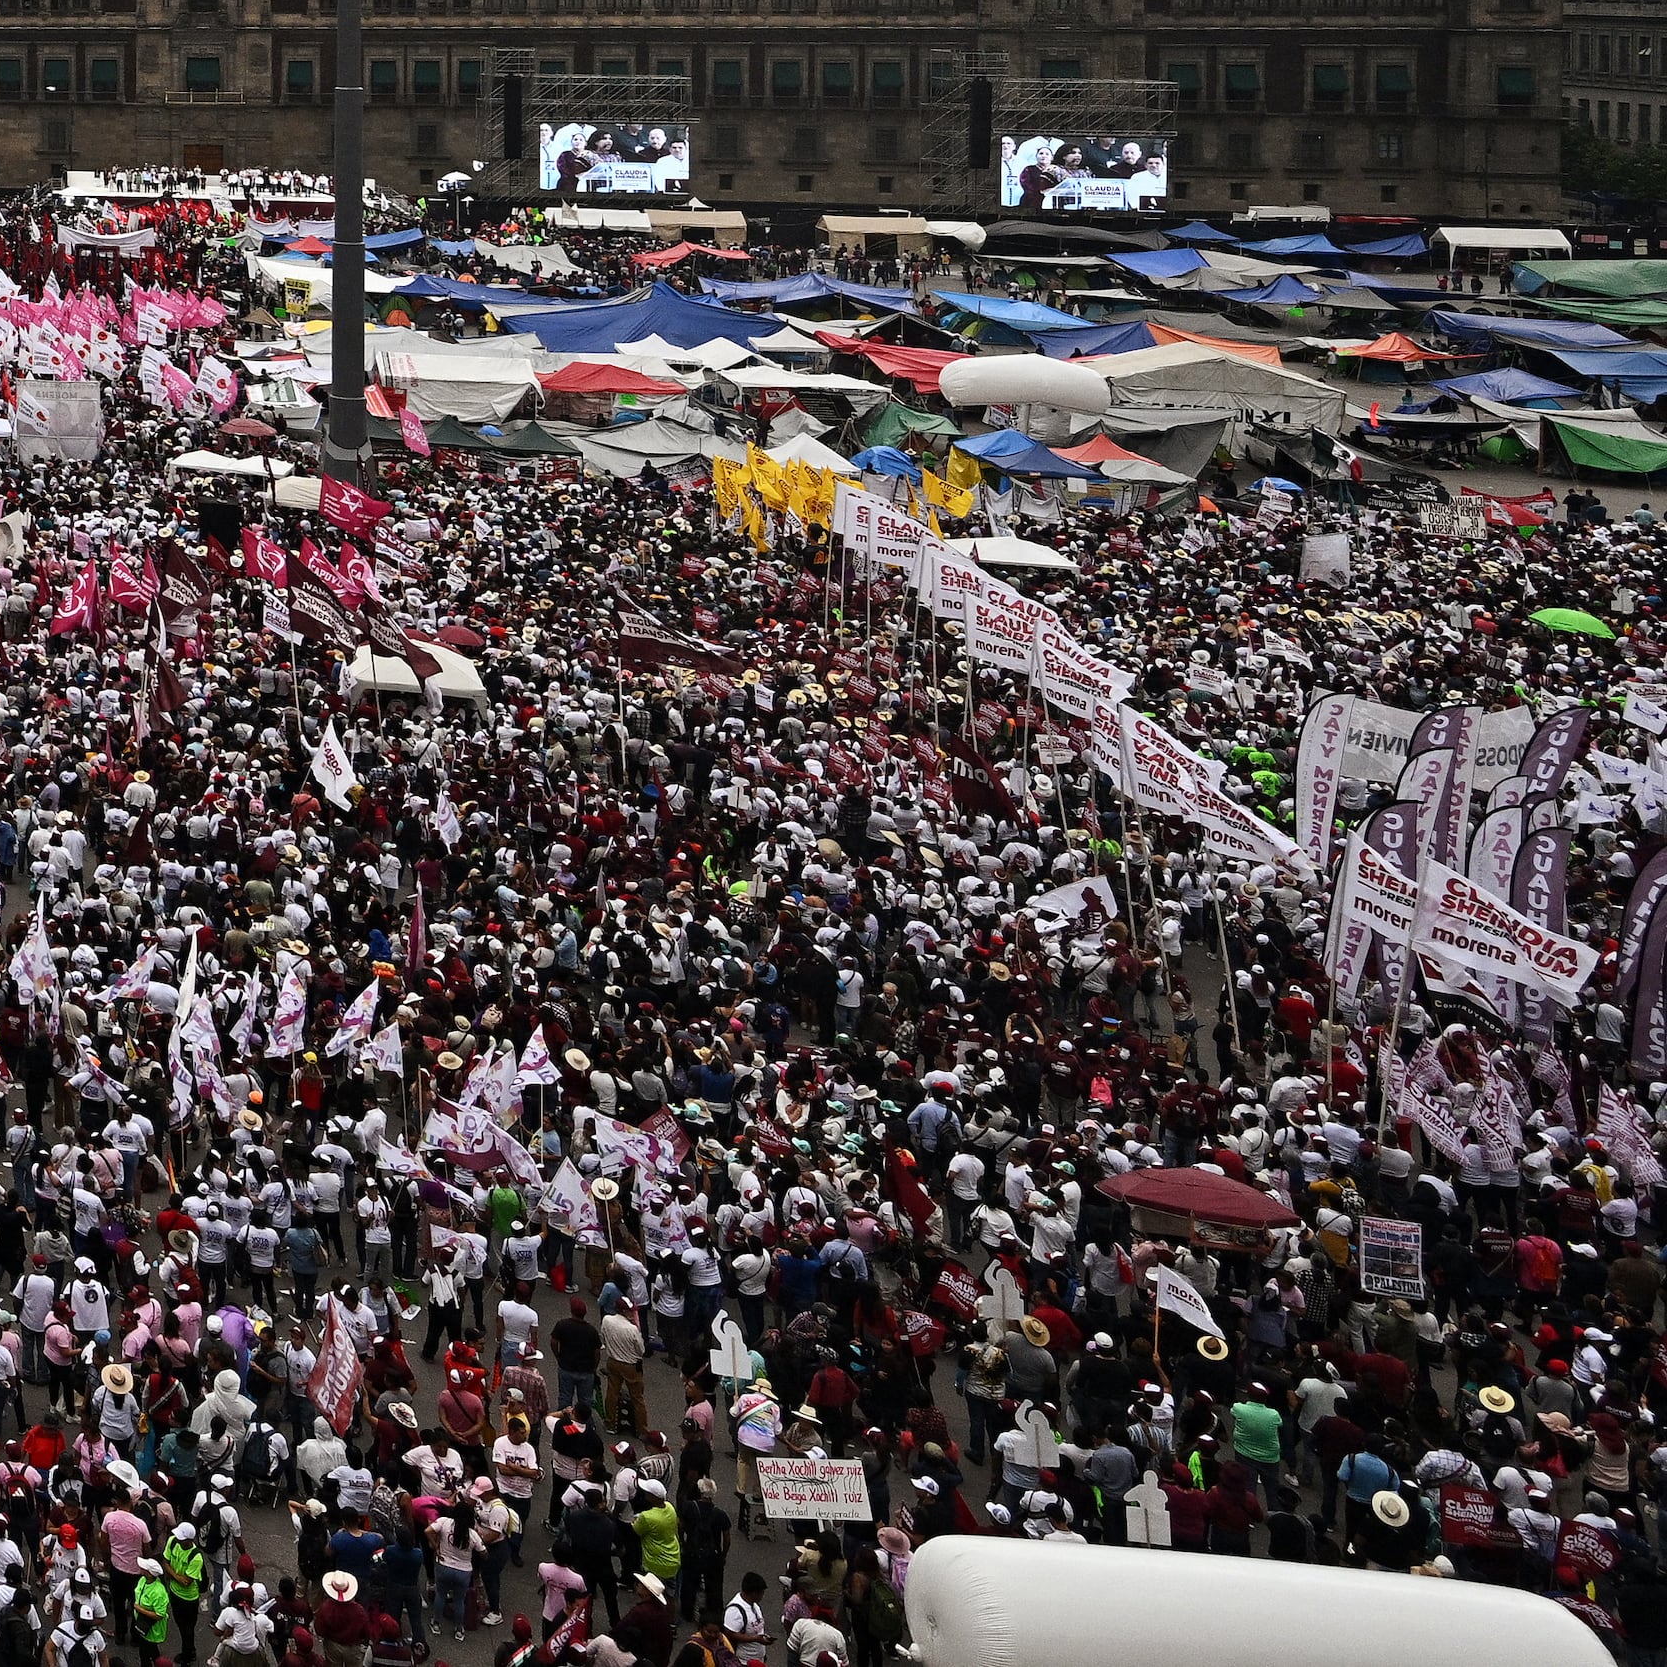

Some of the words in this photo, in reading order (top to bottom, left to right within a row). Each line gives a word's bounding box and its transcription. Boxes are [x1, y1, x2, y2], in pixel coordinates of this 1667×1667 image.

[987, 590, 1056, 623] CLAUD
[975, 639, 1026, 661] morena
[1046, 687, 1087, 710] morena
[1352, 896, 1414, 930] moren
[1431, 926, 1517, 965] morena
